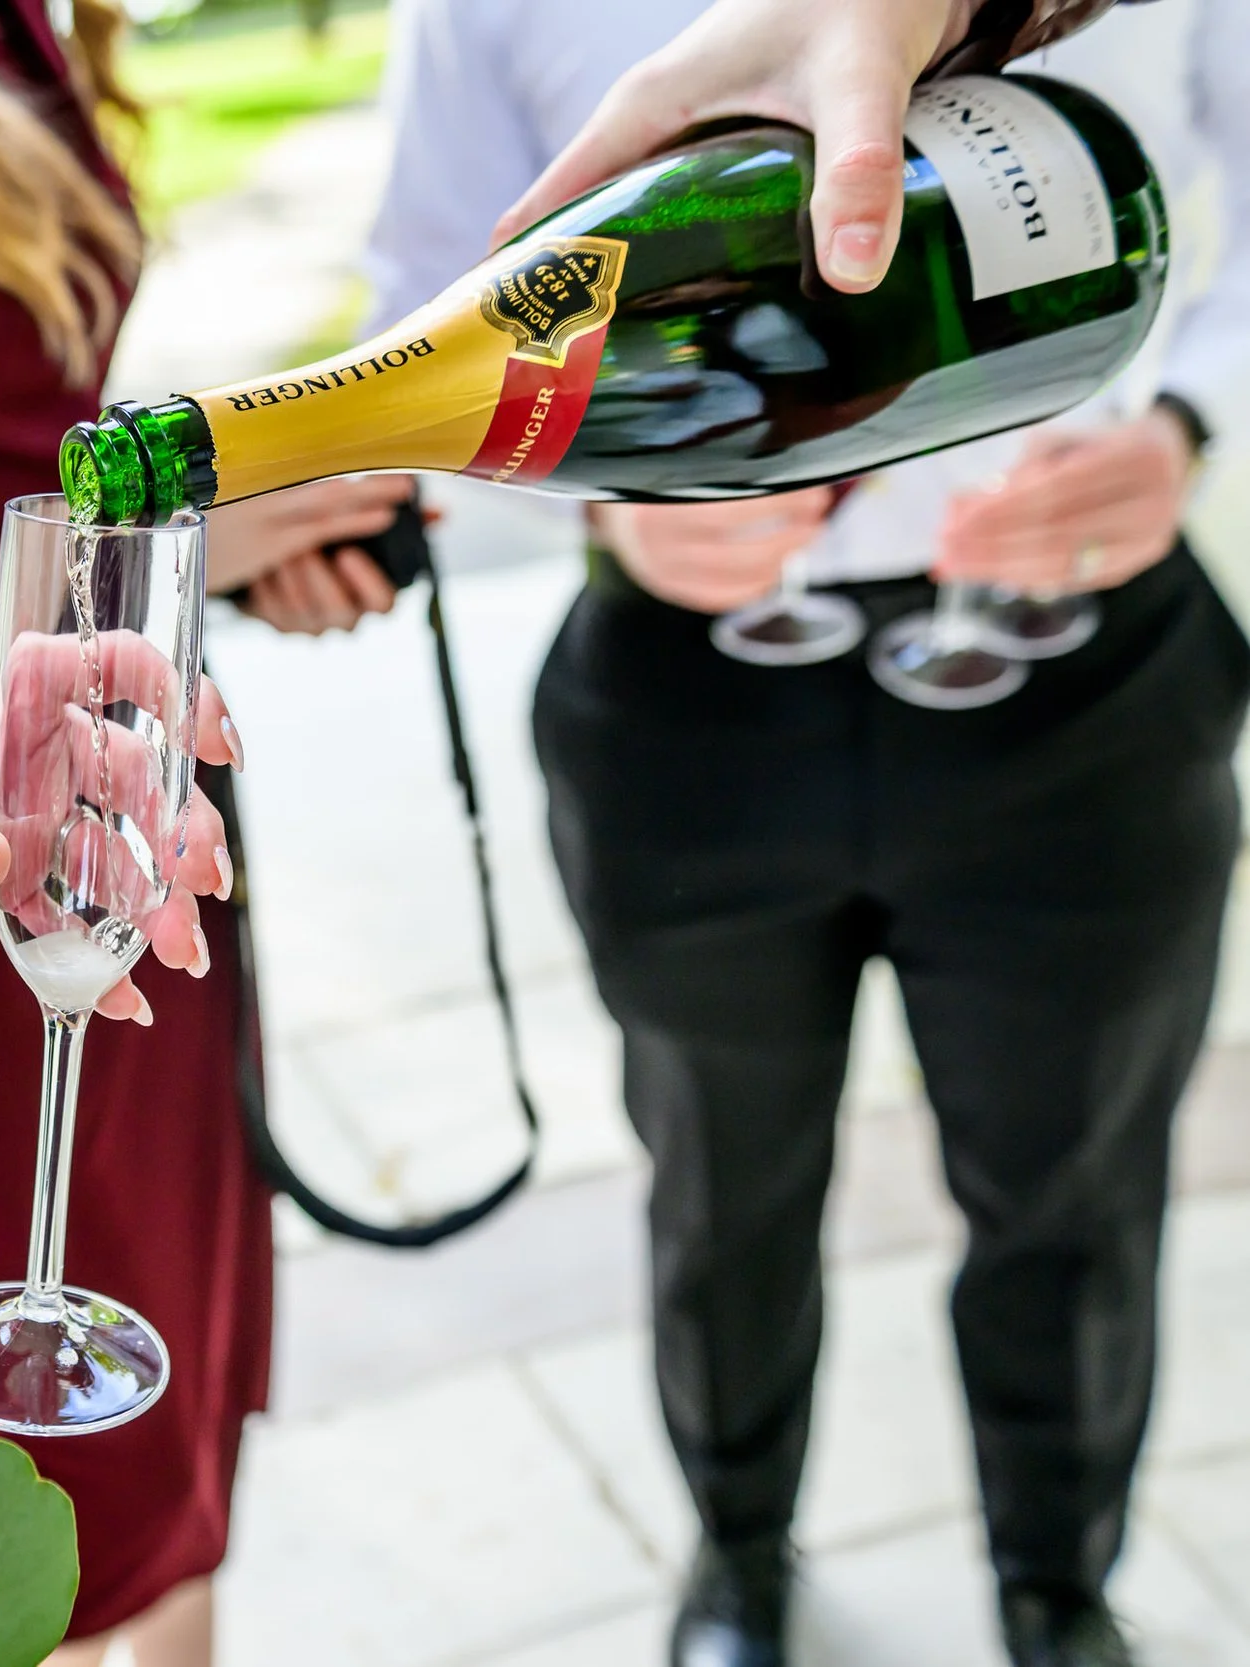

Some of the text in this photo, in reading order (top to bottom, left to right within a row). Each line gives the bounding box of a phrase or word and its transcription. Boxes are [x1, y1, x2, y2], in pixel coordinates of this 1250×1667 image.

[914, 90, 1047, 241] BOLLING
[535, 265, 570, 302] 1829
[225, 336, 436, 412] BOLLINGER
[492, 387, 556, 483] OLLINGER
